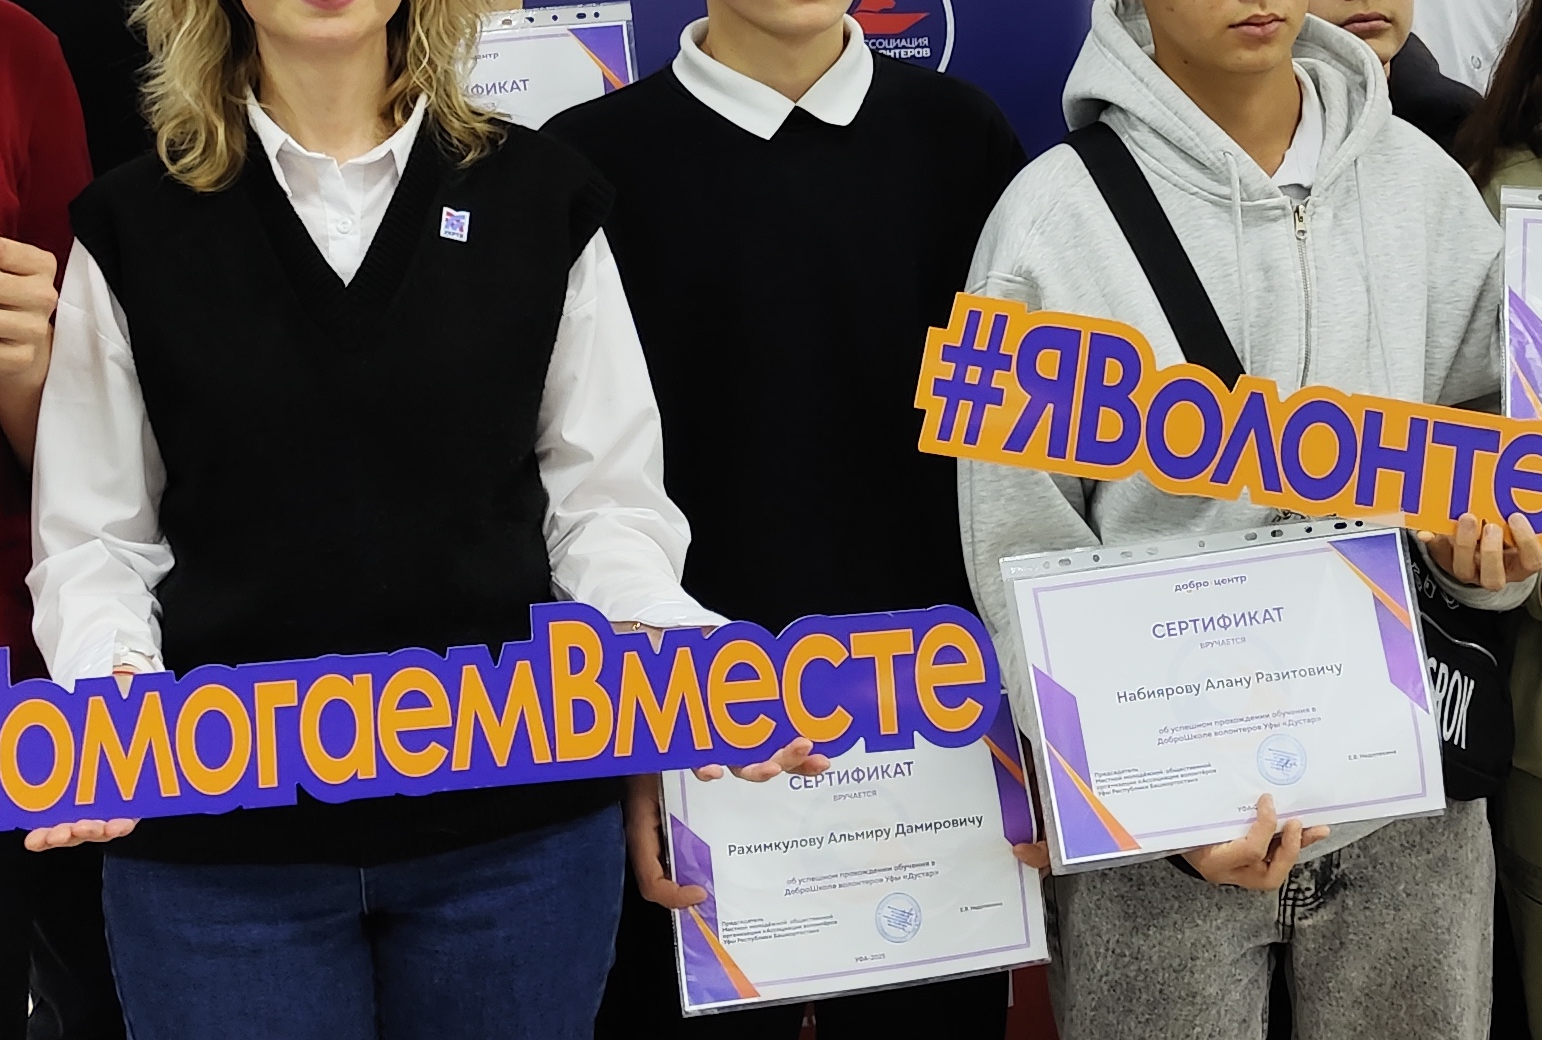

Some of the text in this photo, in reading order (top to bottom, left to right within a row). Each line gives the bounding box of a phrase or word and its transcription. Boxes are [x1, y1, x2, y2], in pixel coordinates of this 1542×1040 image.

[1152, 606, 1284, 639] СЕРТИФИКАТ
[1116, 663, 1343, 704] Набиярову Алану Разитовичу
[789, 760, 914, 791] СЕРТИФИКАТ
[727, 815, 984, 857] Рахимкулову Альмиру Дамировичу
